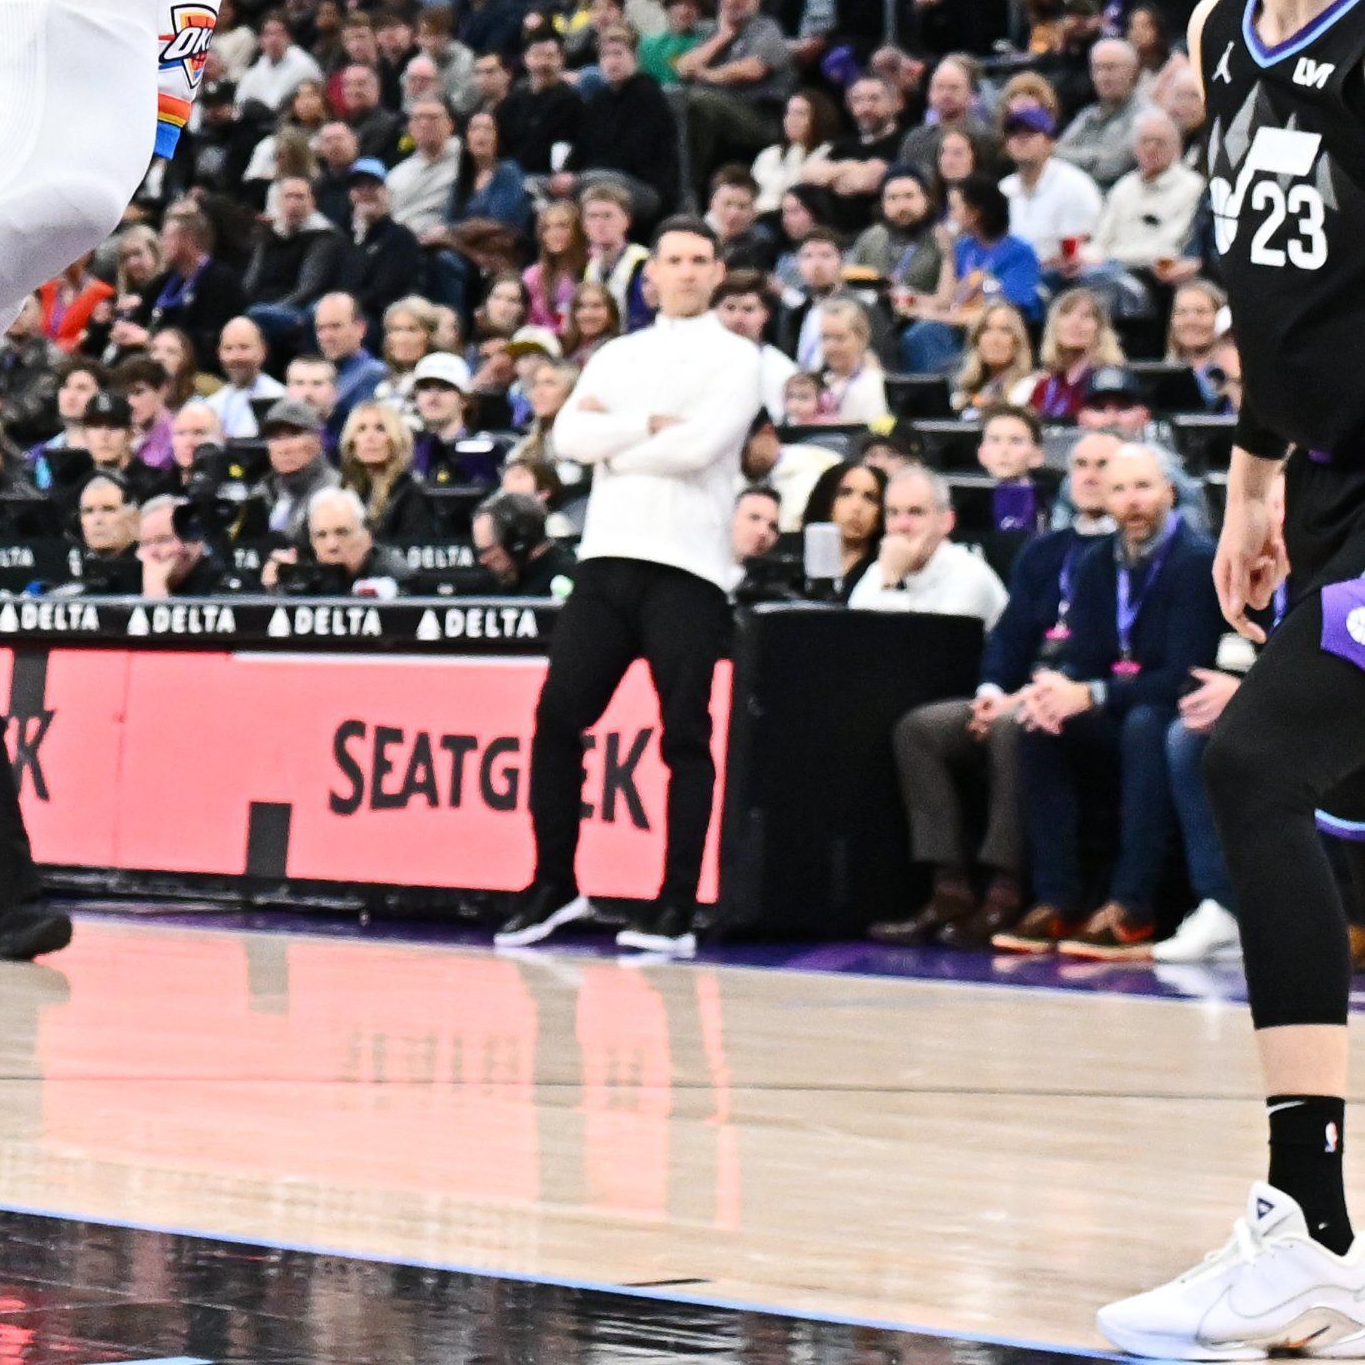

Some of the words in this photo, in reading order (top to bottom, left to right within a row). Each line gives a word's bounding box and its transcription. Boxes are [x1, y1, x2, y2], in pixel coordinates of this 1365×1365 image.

[162, 26, 214, 61] OK
[1250, 179, 1329, 270] 23
[407, 544, 475, 569] DELTA
[21, 603, 100, 631] DELTA
[152, 605, 235, 635] DELTA
[294, 606, 382, 636] DELTA
[444, 608, 538, 639] DELTA
[328, 718, 654, 831] SEATGK
